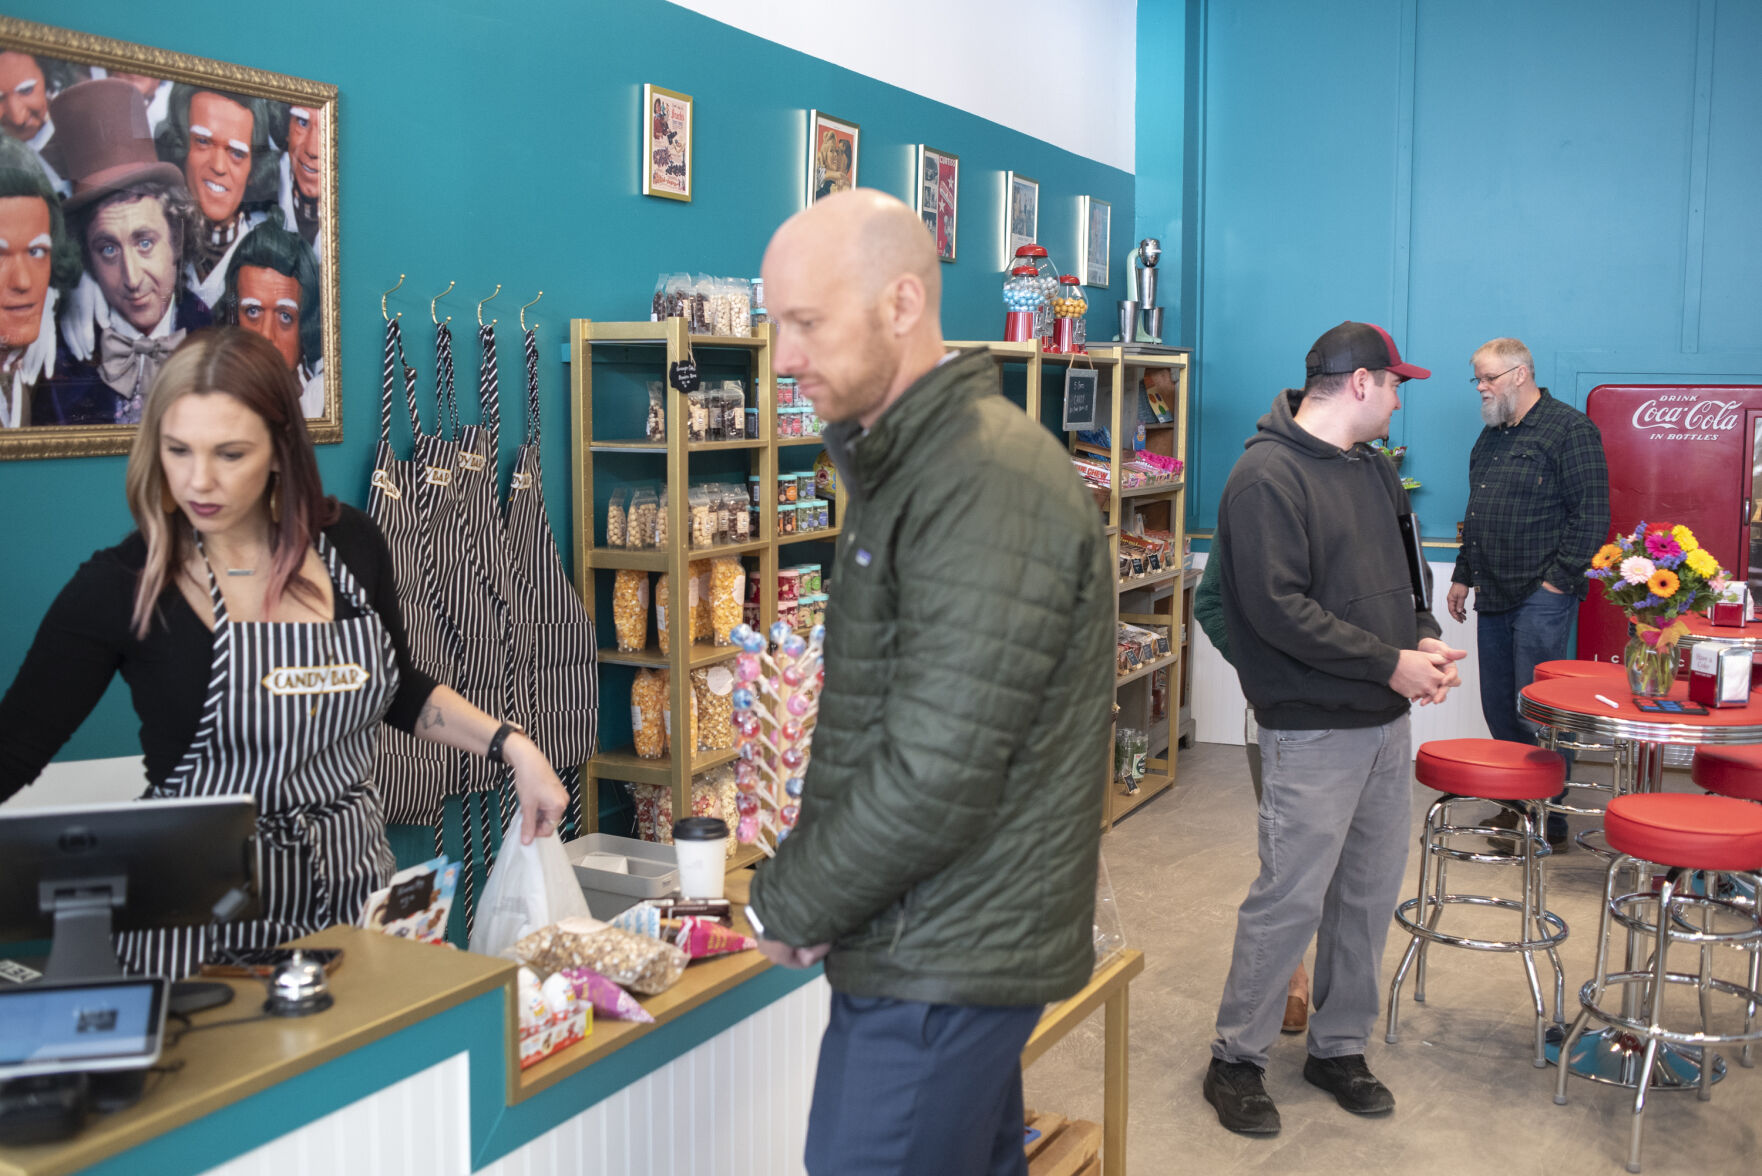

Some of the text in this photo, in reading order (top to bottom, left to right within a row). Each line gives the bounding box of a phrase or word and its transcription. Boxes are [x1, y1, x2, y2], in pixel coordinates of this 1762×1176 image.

[1632, 400, 1744, 430] Coca-Cola
[1667, 433, 1720, 441] BOTTLES
[1087, 465, 1109, 480] CHEW
[274, 670, 359, 690] CANDY BAR
